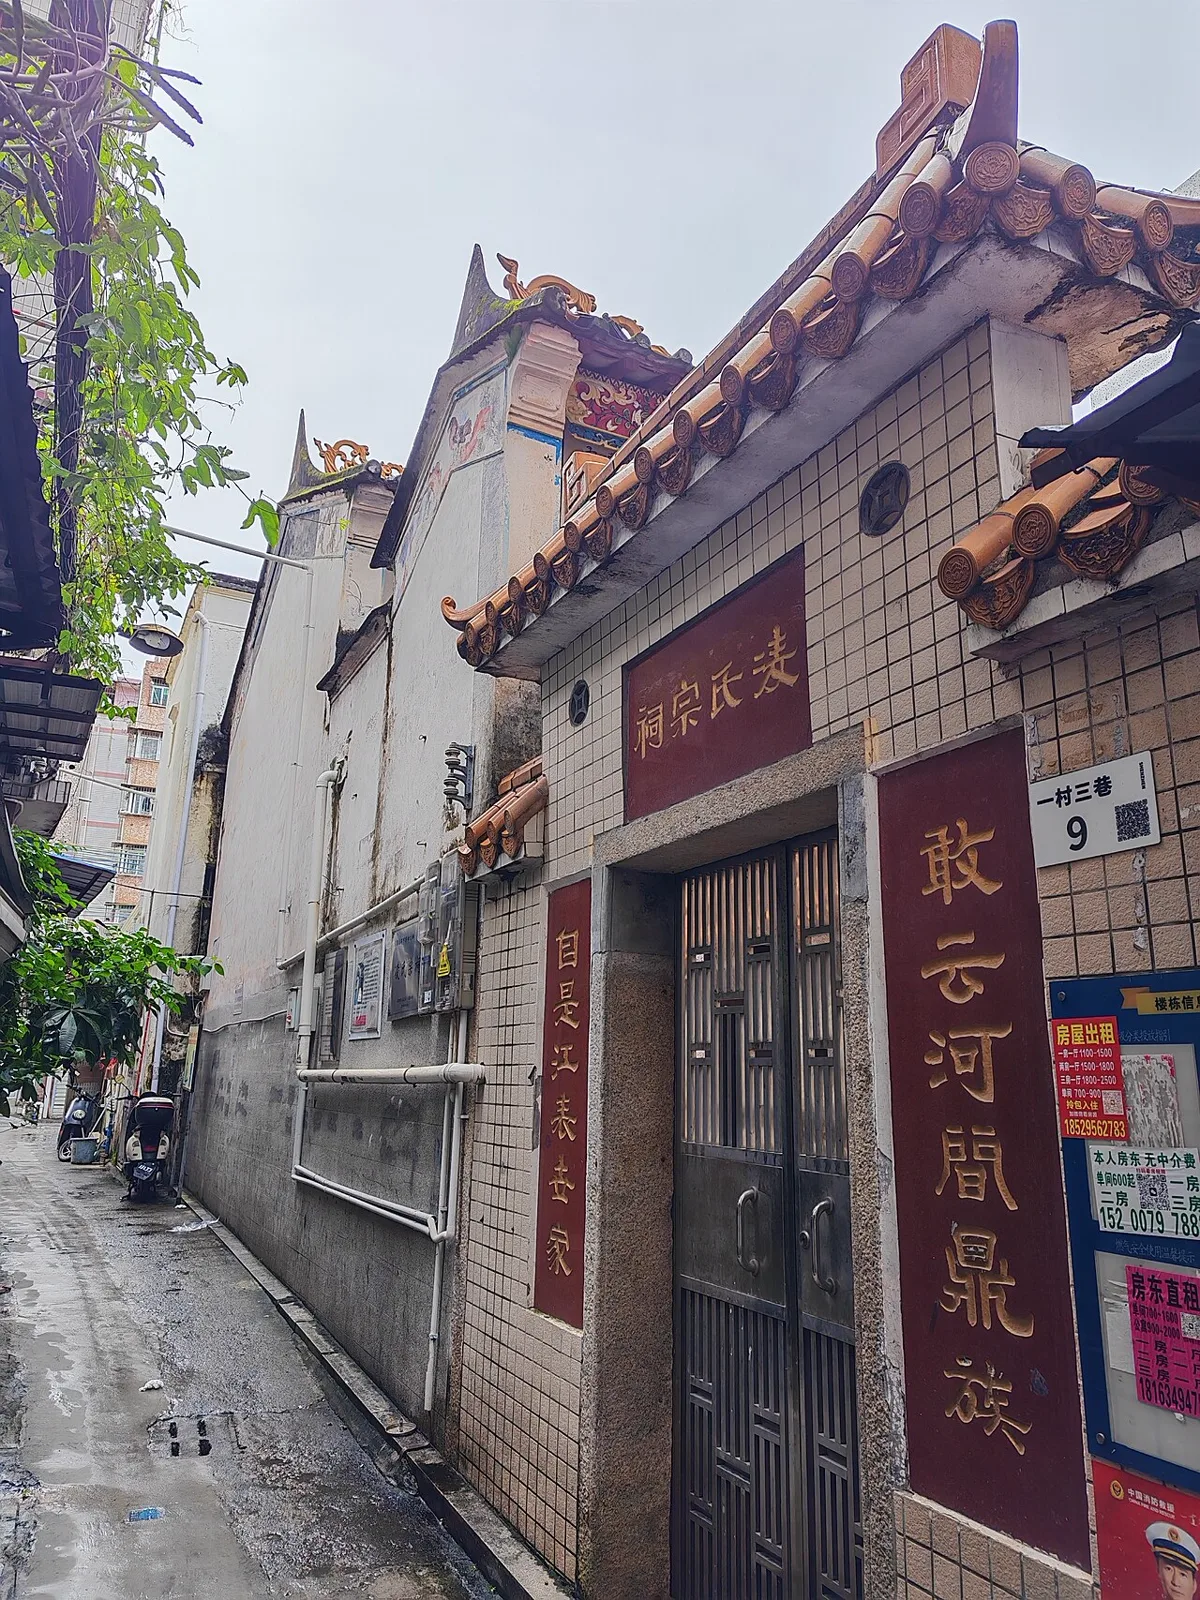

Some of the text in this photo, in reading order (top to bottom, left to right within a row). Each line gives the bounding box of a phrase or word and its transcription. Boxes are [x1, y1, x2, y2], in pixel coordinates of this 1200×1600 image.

[1037, 775, 1112, 808] 一村三巷
[1066, 816, 1087, 851] 9
[1057, 1022, 1115, 1046] 房屋出租
[1066, 1099, 1099, 1111] 拎包入住
[1064, 1119, 1126, 1138] 18529562783
[1094, 1150, 1196, 1169] 本人房东 无中介费
[1097, 1171, 1136, 1188] 单间600起
[1101, 1191, 1128, 1207] 二房
[1100, 1206, 1200, 1238] 152 0079 788
[1131, 1272, 1200, 1311] 房东直租
[1139, 1376, 1200, 1417] 181634947
[1127, 1487, 1176, 1514] 中国消防救援
